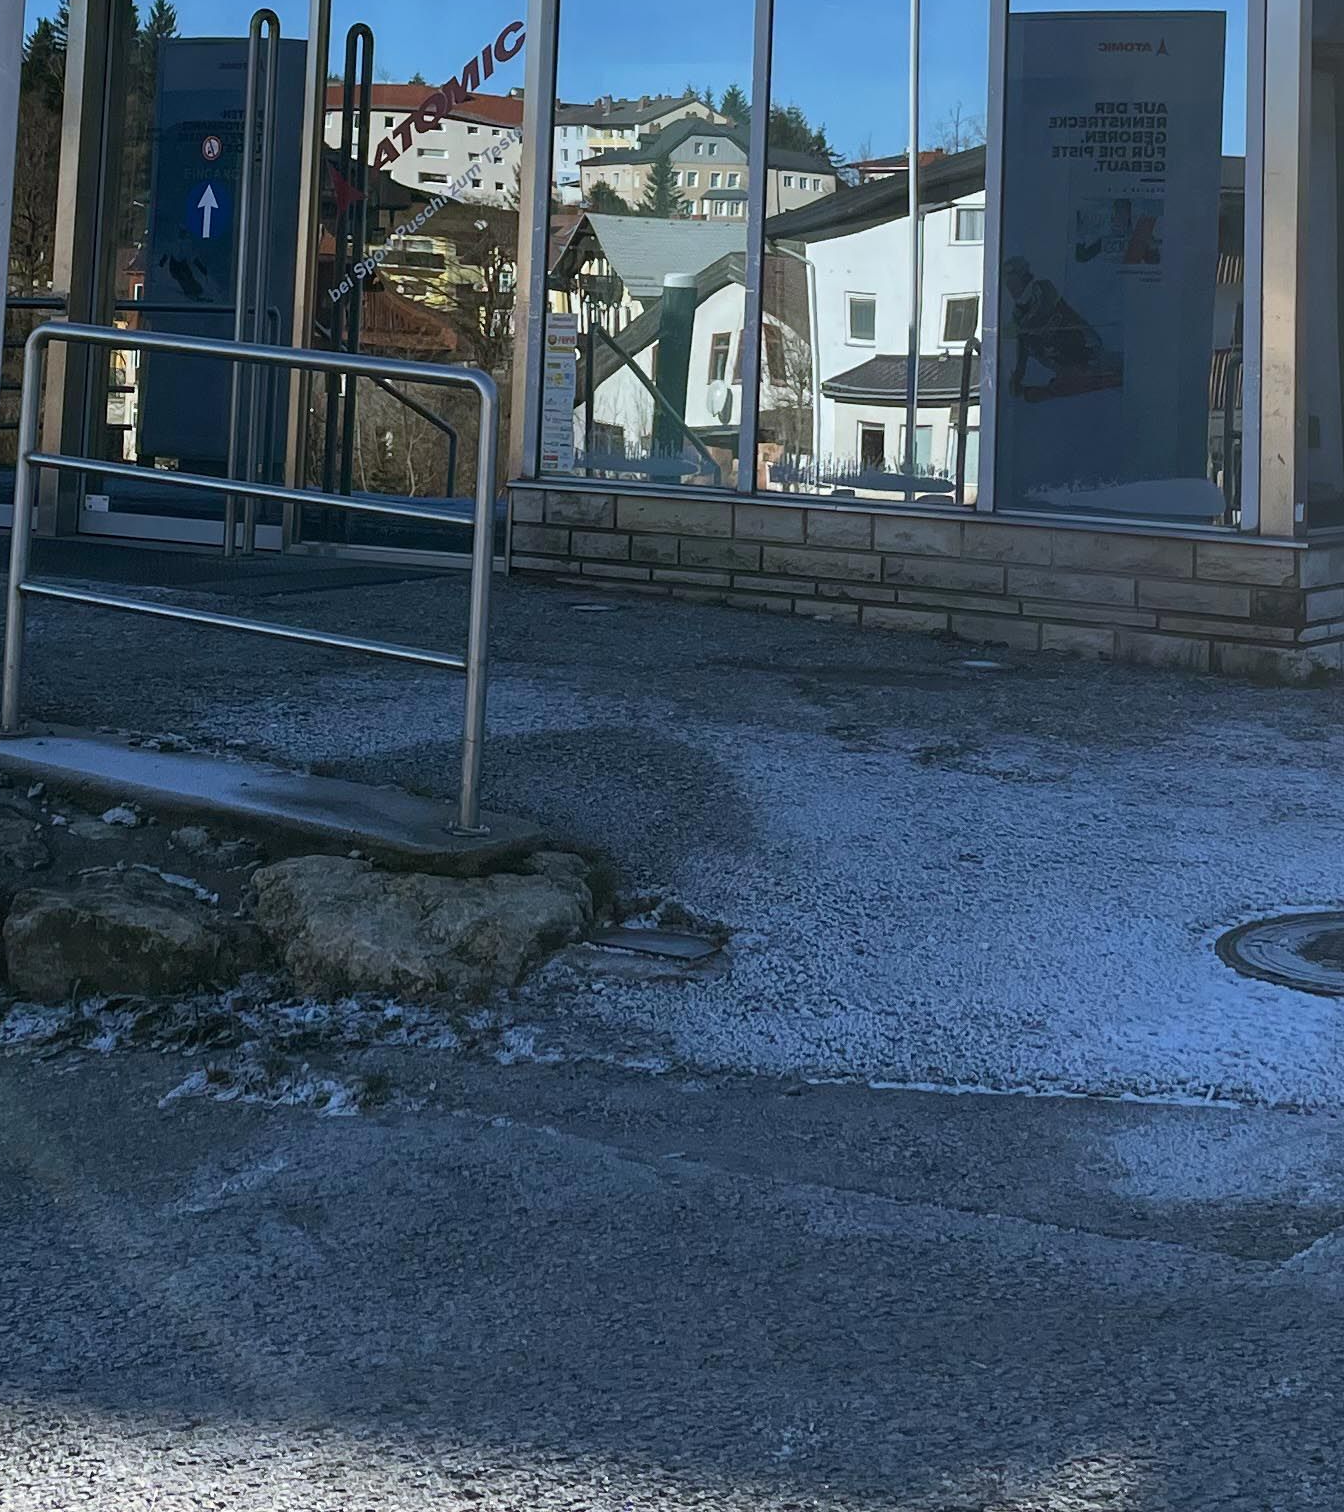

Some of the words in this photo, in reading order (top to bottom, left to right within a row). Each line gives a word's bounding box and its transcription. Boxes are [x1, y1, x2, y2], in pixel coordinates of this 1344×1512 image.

[372, 20, 526, 178] ATOMIC
[327, 270, 355, 303] bei
[394, 190, 449, 251] Puschi
[448, 163, 482, 200] zum
